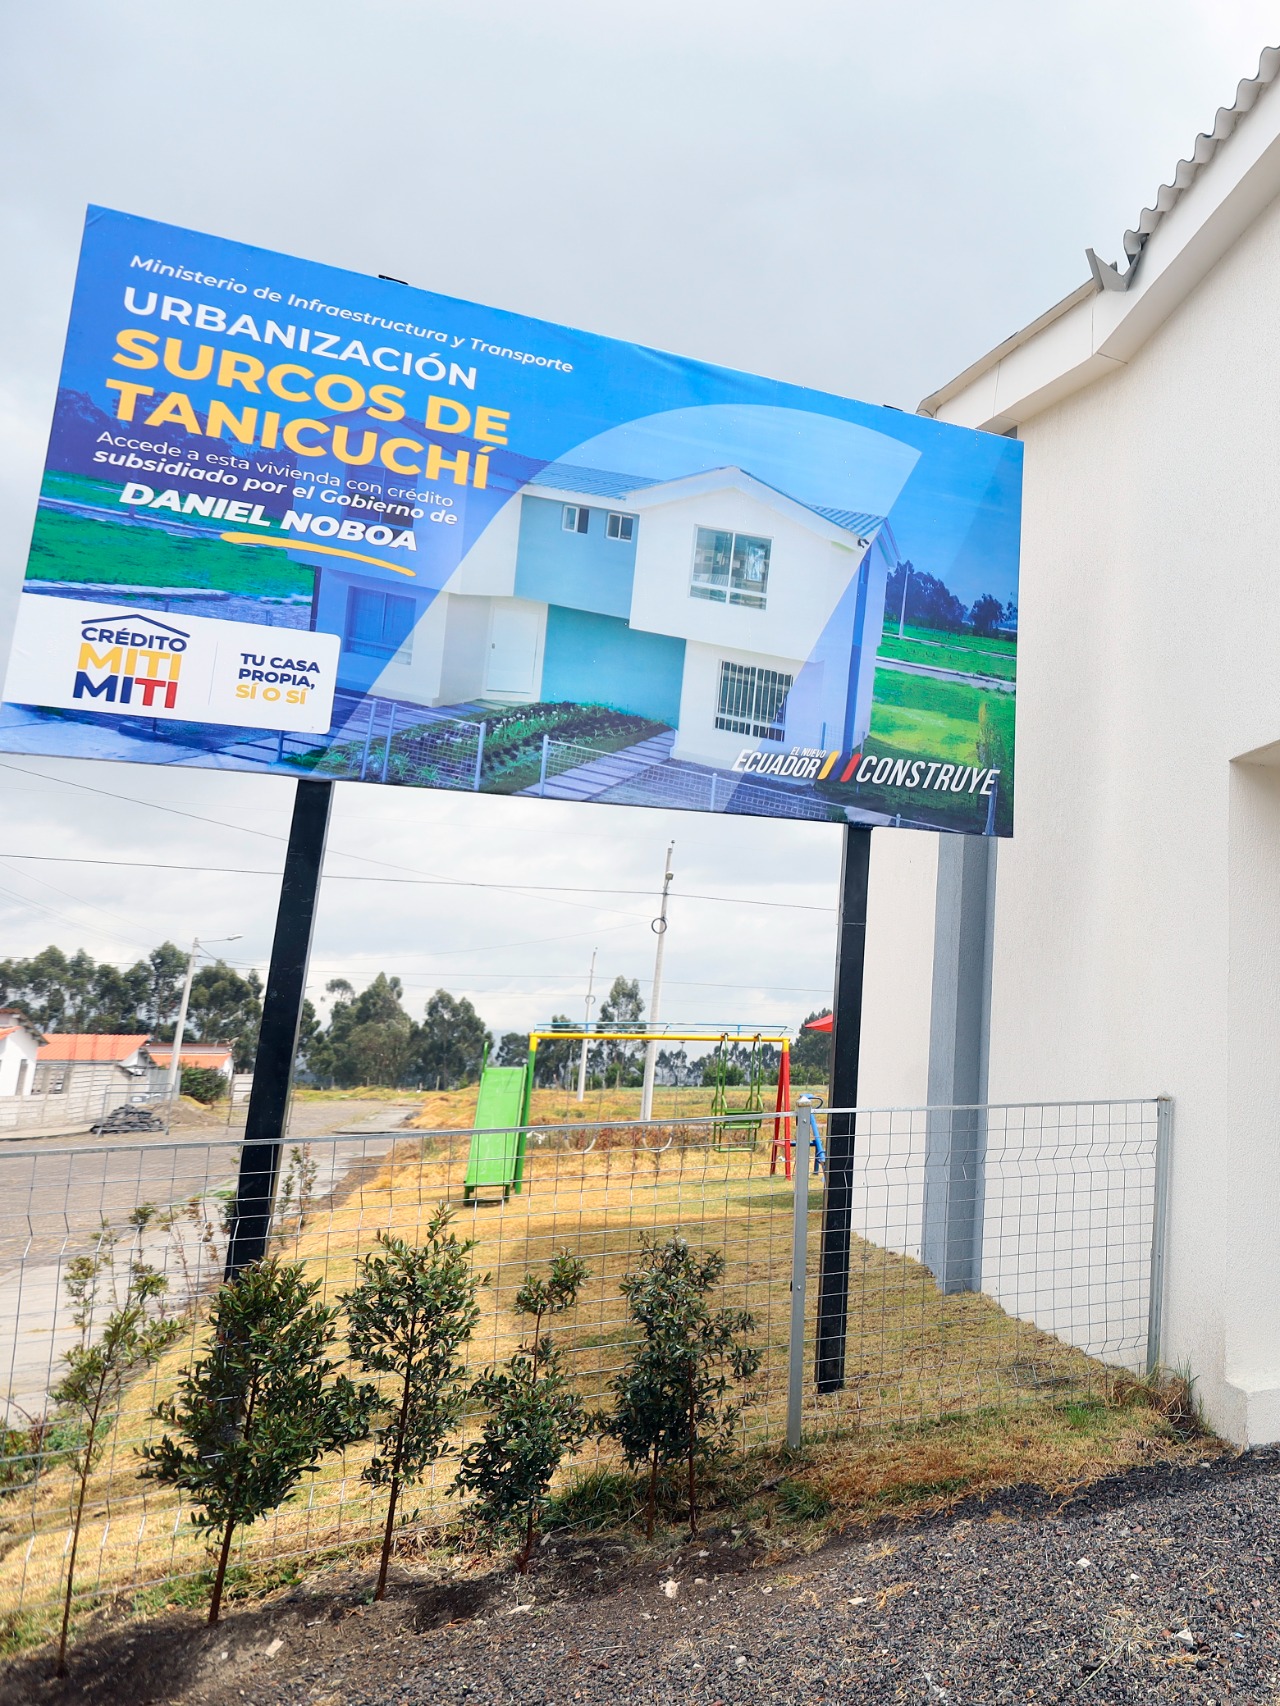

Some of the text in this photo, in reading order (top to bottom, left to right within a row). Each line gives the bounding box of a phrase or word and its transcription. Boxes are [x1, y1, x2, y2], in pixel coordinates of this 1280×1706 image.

[124, 286, 477, 390] URBANIZACIÓN
[130, 255, 573, 373] Ministerio de Infraestructura y Transporte
[112, 328, 510, 445] SURCOS DE
[105, 378, 490, 489] TANICUCHÍ
[93, 450, 458, 525] subsidiado por el Gobierno de
[96, 431, 453, 507] Accede a esta vivienda con crédito
[119, 482, 417, 551] DANIEL NOBOA
[77, 642, 182, 681] MITI
[81, 627, 187, 652] CRÉDITO
[240, 653, 320, 674] TU CASA
[72, 671, 178, 709] MITI
[235, 683, 307, 705] SÍ O SÍ
[238, 668, 315, 690] PROPIA,
[730, 748, 1001, 796] ECUADOR CONSTRUYE
[790, 746, 827, 759] EL NUEVO
